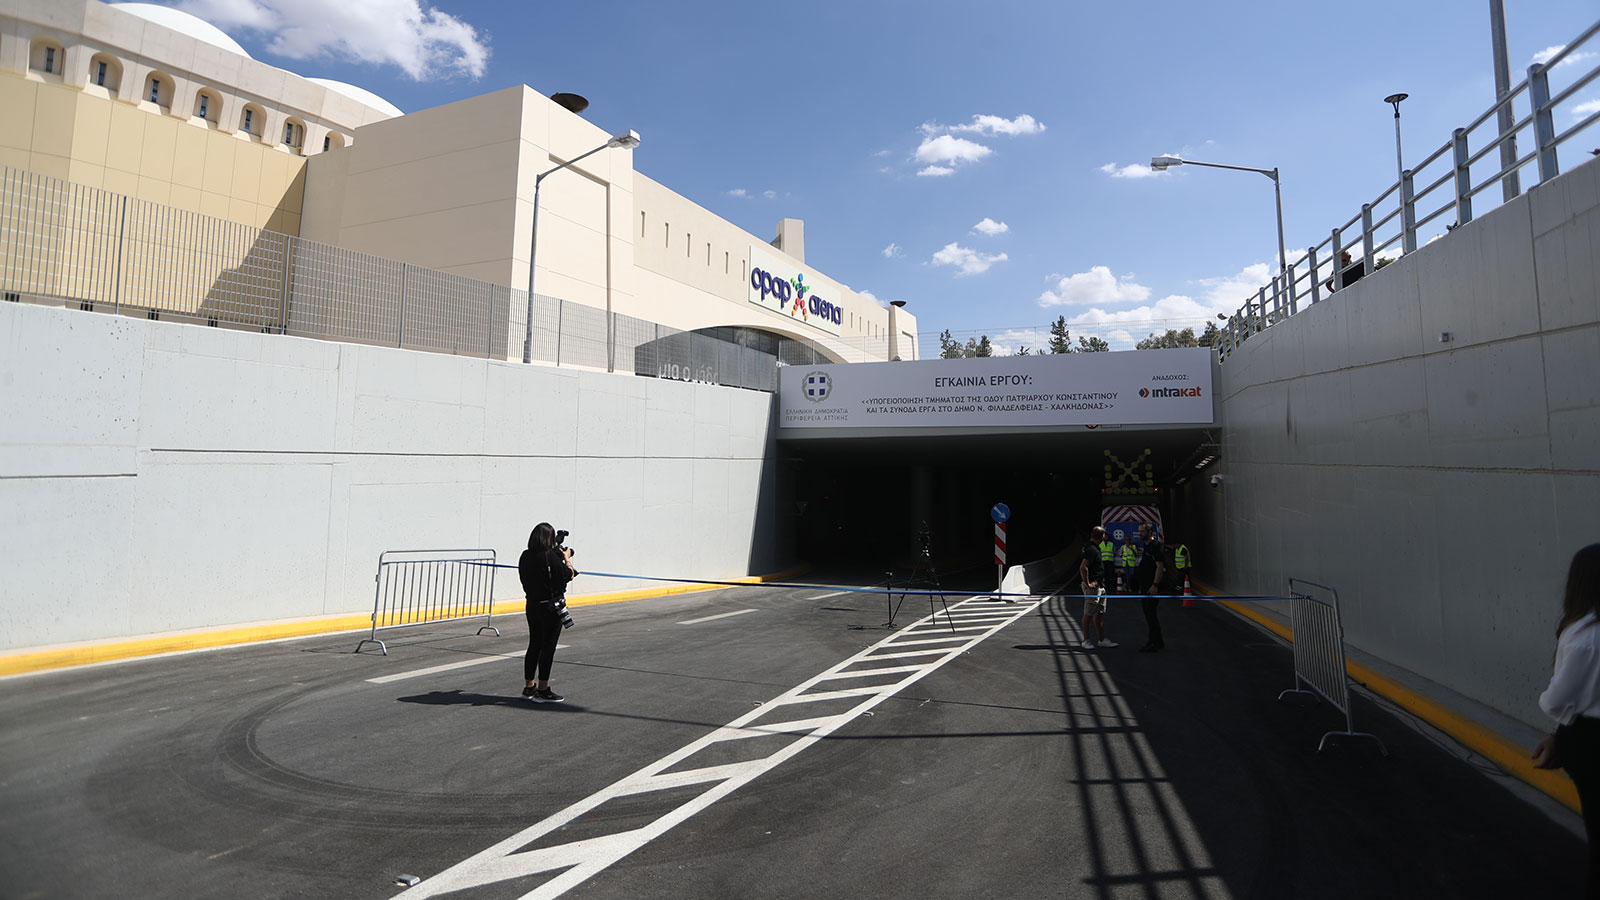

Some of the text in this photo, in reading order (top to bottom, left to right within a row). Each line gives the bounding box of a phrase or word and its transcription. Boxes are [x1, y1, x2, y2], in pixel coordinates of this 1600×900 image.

[751, 267, 842, 325] opap arena
[935, 375, 1032, 387] ΕΓΚΑΙΝΙΑ ΕΡΓΟΥ:
[983, 395, 1004, 403] ΟΔΟΥ
[1006, 394, 1054, 402] ΠΑΤΡΙΑΡΧΟΥ
[1056, 393, 1118, 401] ΚΩΝΣΤΑΝΤΙΝΟΥ
[1152, 386, 1202, 398] intrakat
[987, 403, 1043, 411] ΦΙΛΑΔΕΛΦΕΙΑΣ
[1050, 402, 1114, 410] ΧΑΛΚΗΔΟΝΑΣ>>
